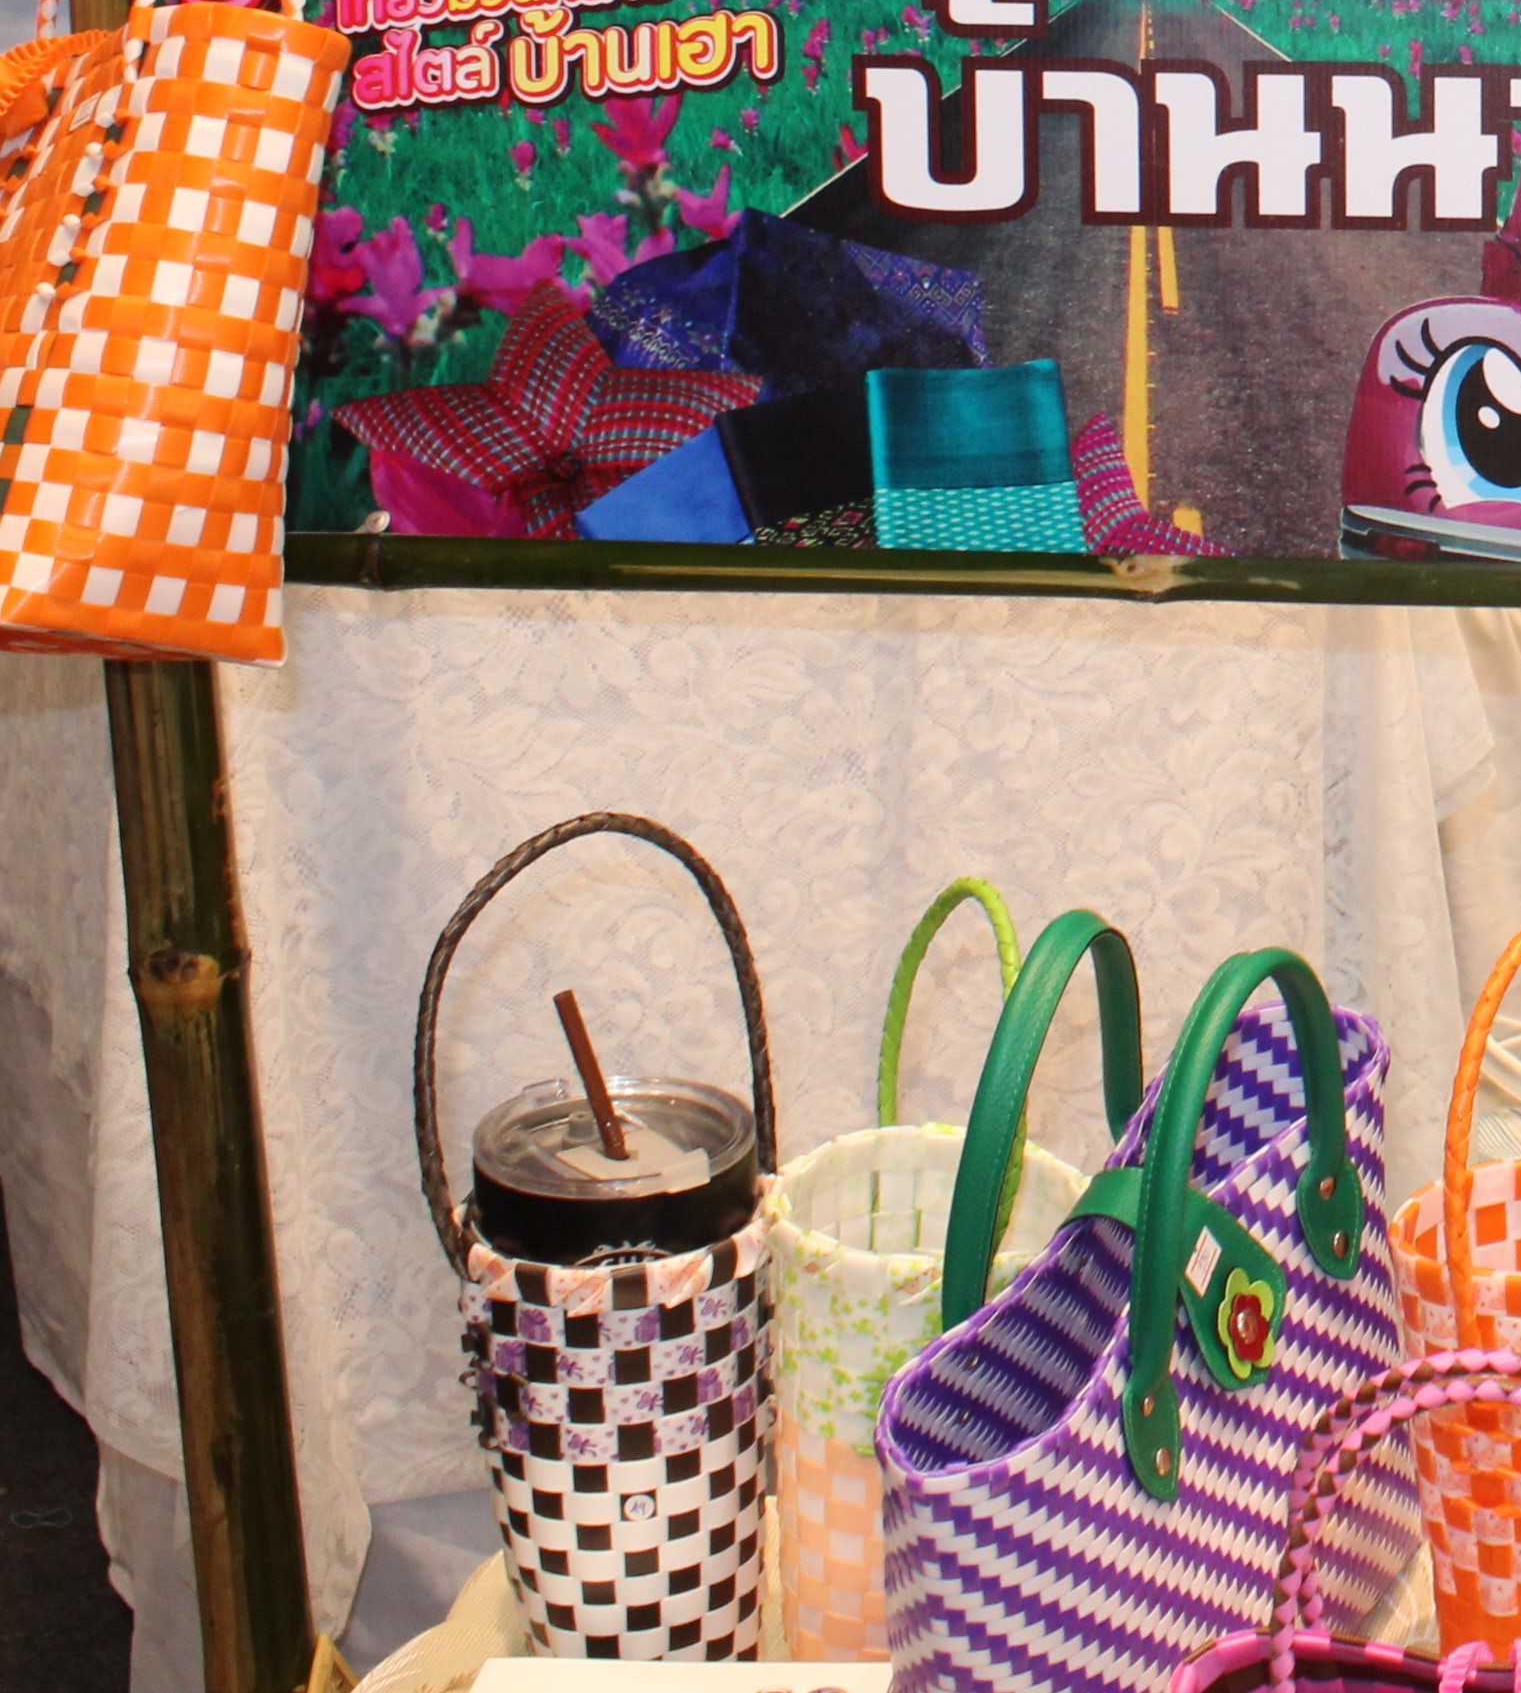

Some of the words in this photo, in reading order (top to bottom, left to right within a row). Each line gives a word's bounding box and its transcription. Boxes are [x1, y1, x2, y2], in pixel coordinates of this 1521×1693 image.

[354, 20, 502, 111] สไตล์
[507, 6, 786, 108] บ้านเฮา
